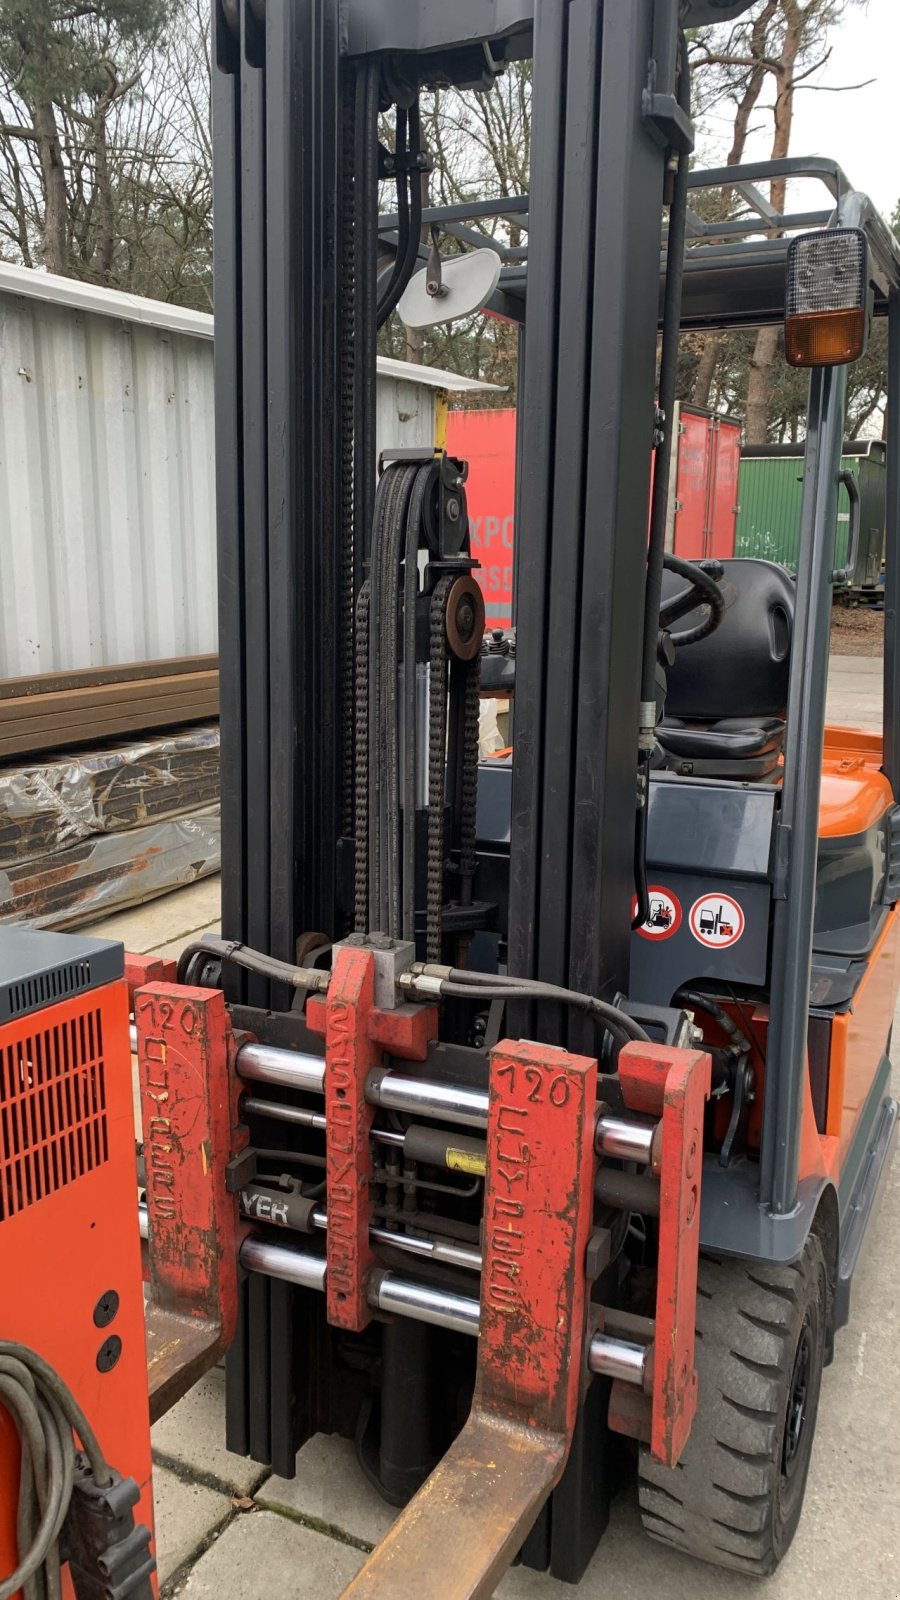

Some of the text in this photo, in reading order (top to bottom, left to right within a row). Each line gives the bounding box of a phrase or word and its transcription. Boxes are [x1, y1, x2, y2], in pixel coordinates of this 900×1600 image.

[139, 1001, 197, 1036] 120
[144, 1036, 177, 1220] CUYPERS
[497, 1063, 571, 1108] 120
[489, 1105, 531, 1314] CUYPERS
